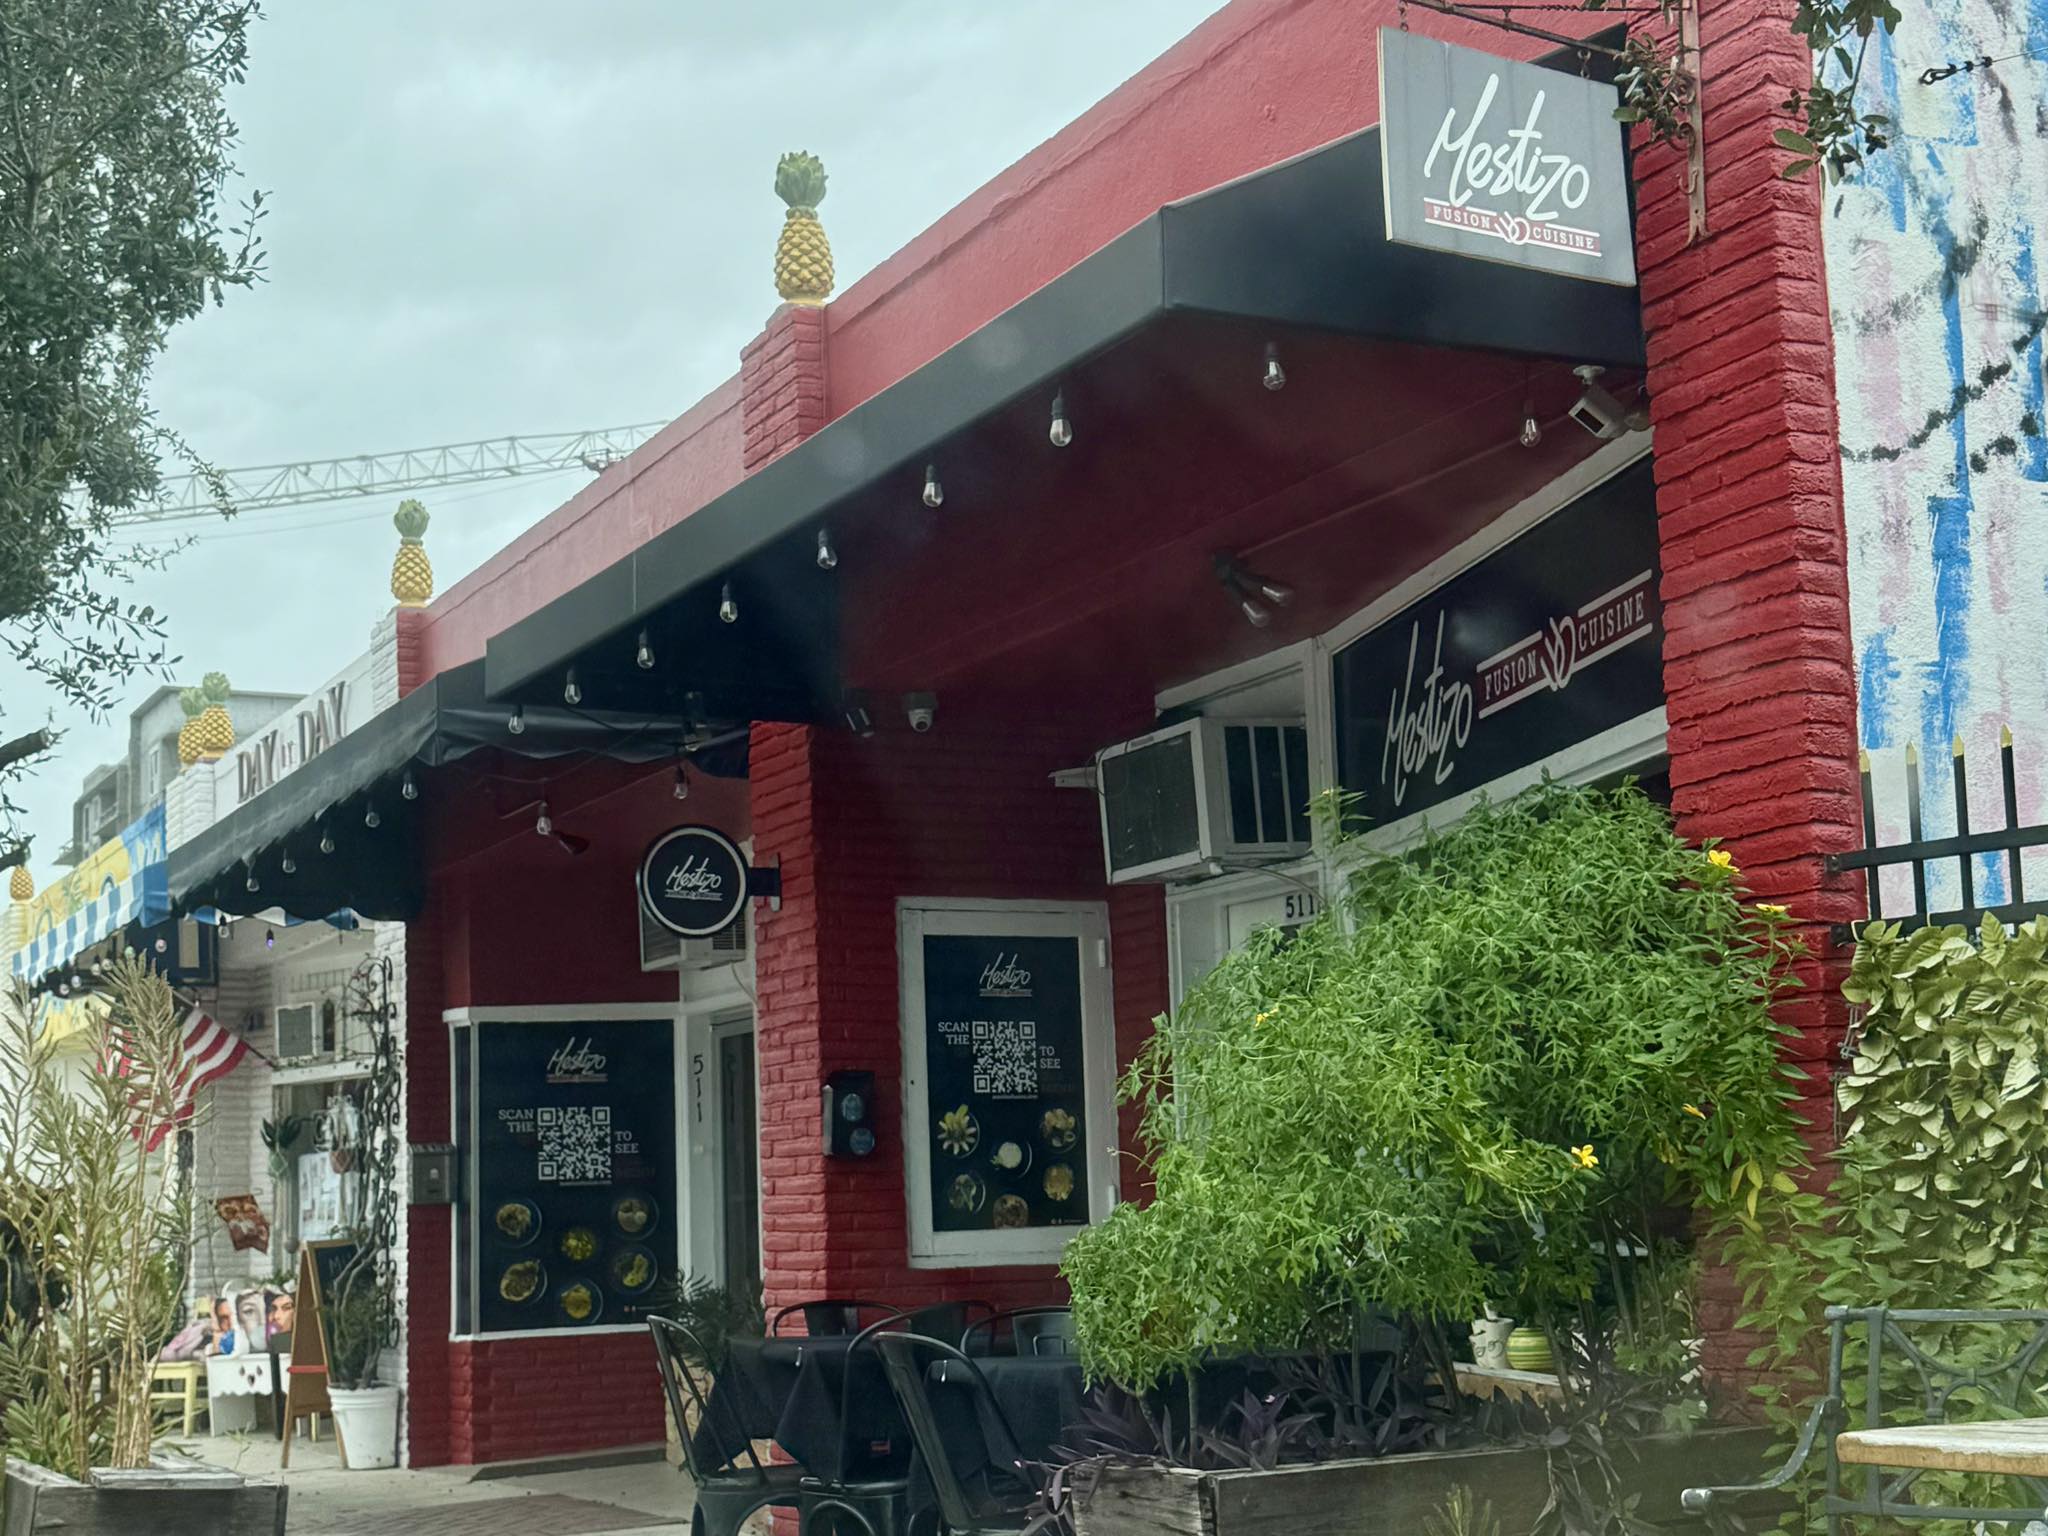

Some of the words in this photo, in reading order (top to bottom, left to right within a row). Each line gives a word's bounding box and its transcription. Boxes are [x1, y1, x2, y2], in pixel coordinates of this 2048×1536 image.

[1424, 73, 1590, 221] Mestizo
[1433, 205, 1492, 230] FUSION
[1532, 227, 1595, 250] CUISINE
[1484, 650, 1537, 701] FUSION
[1577, 591, 1645, 652] CUISINE
[1381, 609, 1473, 806] Mestizo
[237, 729, 278, 804] DAY
[297, 680, 347, 767] DAY
[666, 854, 722, 893] Mestizo
[979, 952, 1031, 990] Mestizo
[938, 1021, 969, 1033] SCAN
[945, 1034, 970, 1045] THE
[1039, 1046, 1055, 1056] TO
[1040, 1058, 1061, 1069] SEE
[693, 1054, 704, 1123] 511
[498, 1109, 534, 1120] SCAN
[506, 1121, 535, 1133] THE
[614, 1130, 632, 1142] TO
[615, 1143, 639, 1154] SEE
